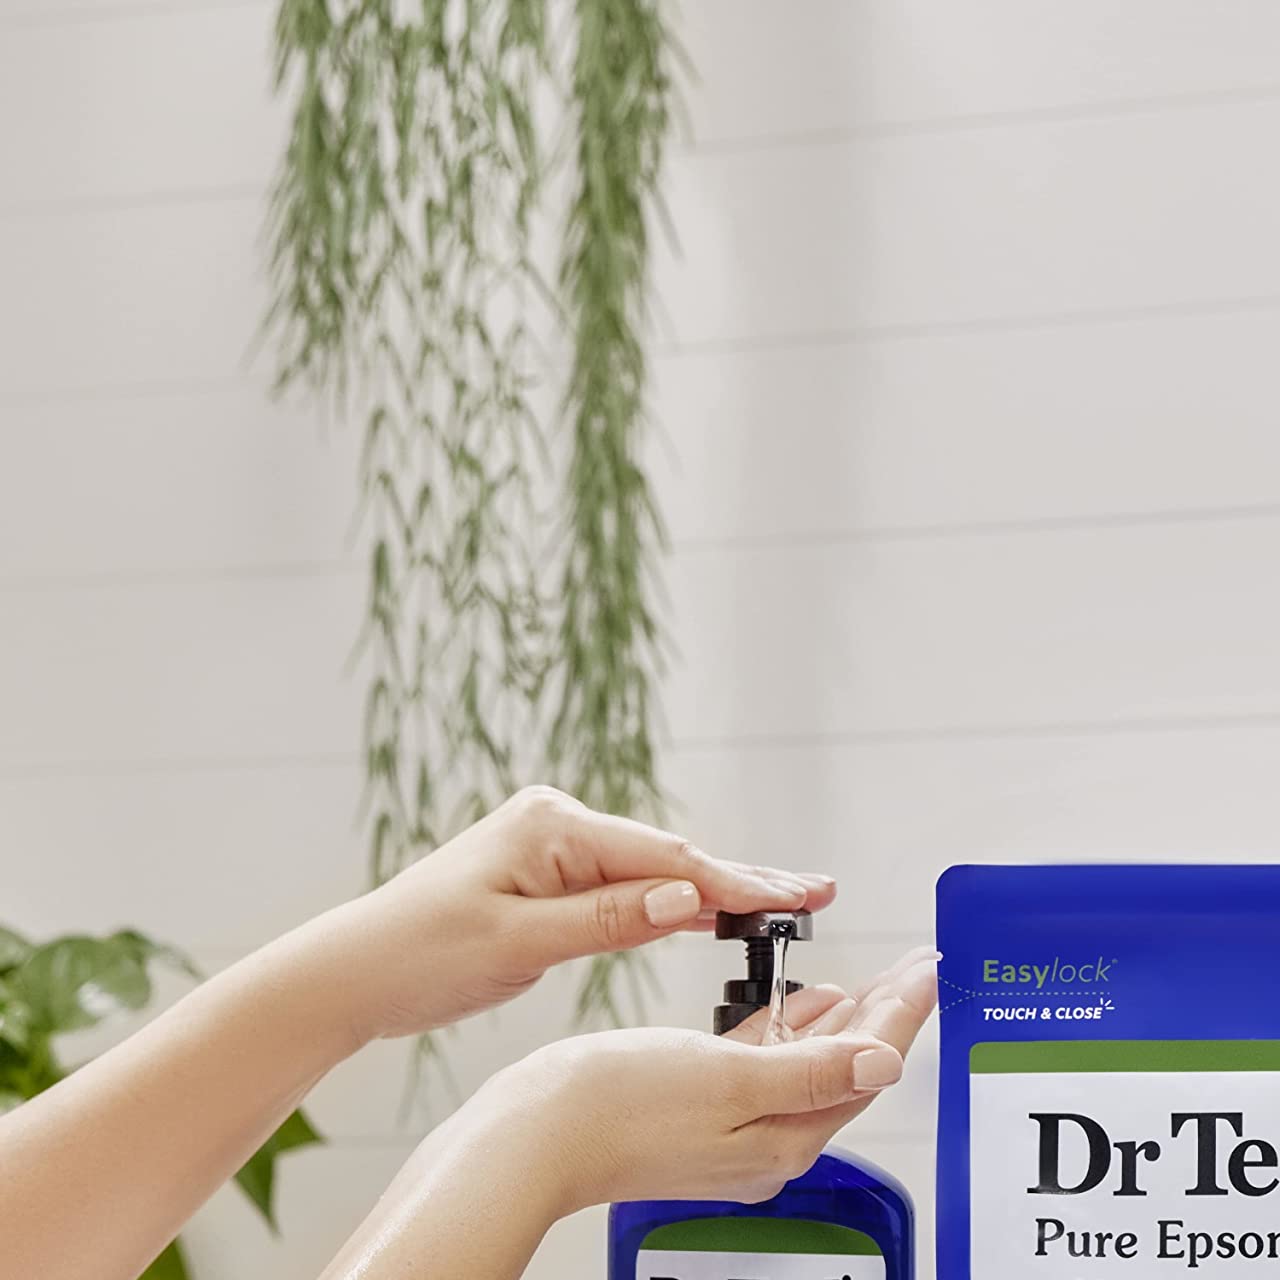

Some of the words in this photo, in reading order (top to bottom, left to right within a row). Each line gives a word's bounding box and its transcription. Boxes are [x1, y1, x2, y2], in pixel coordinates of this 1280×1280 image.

[983, 1007, 1037, 1021] TOUCH
[1040, 1007, 1051, 1020] &
[1055, 1006, 1103, 1020] CLOSE
[1027, 1112, 1161, 1197] Dr
[1034, 1217, 1138, 1259] Pure
